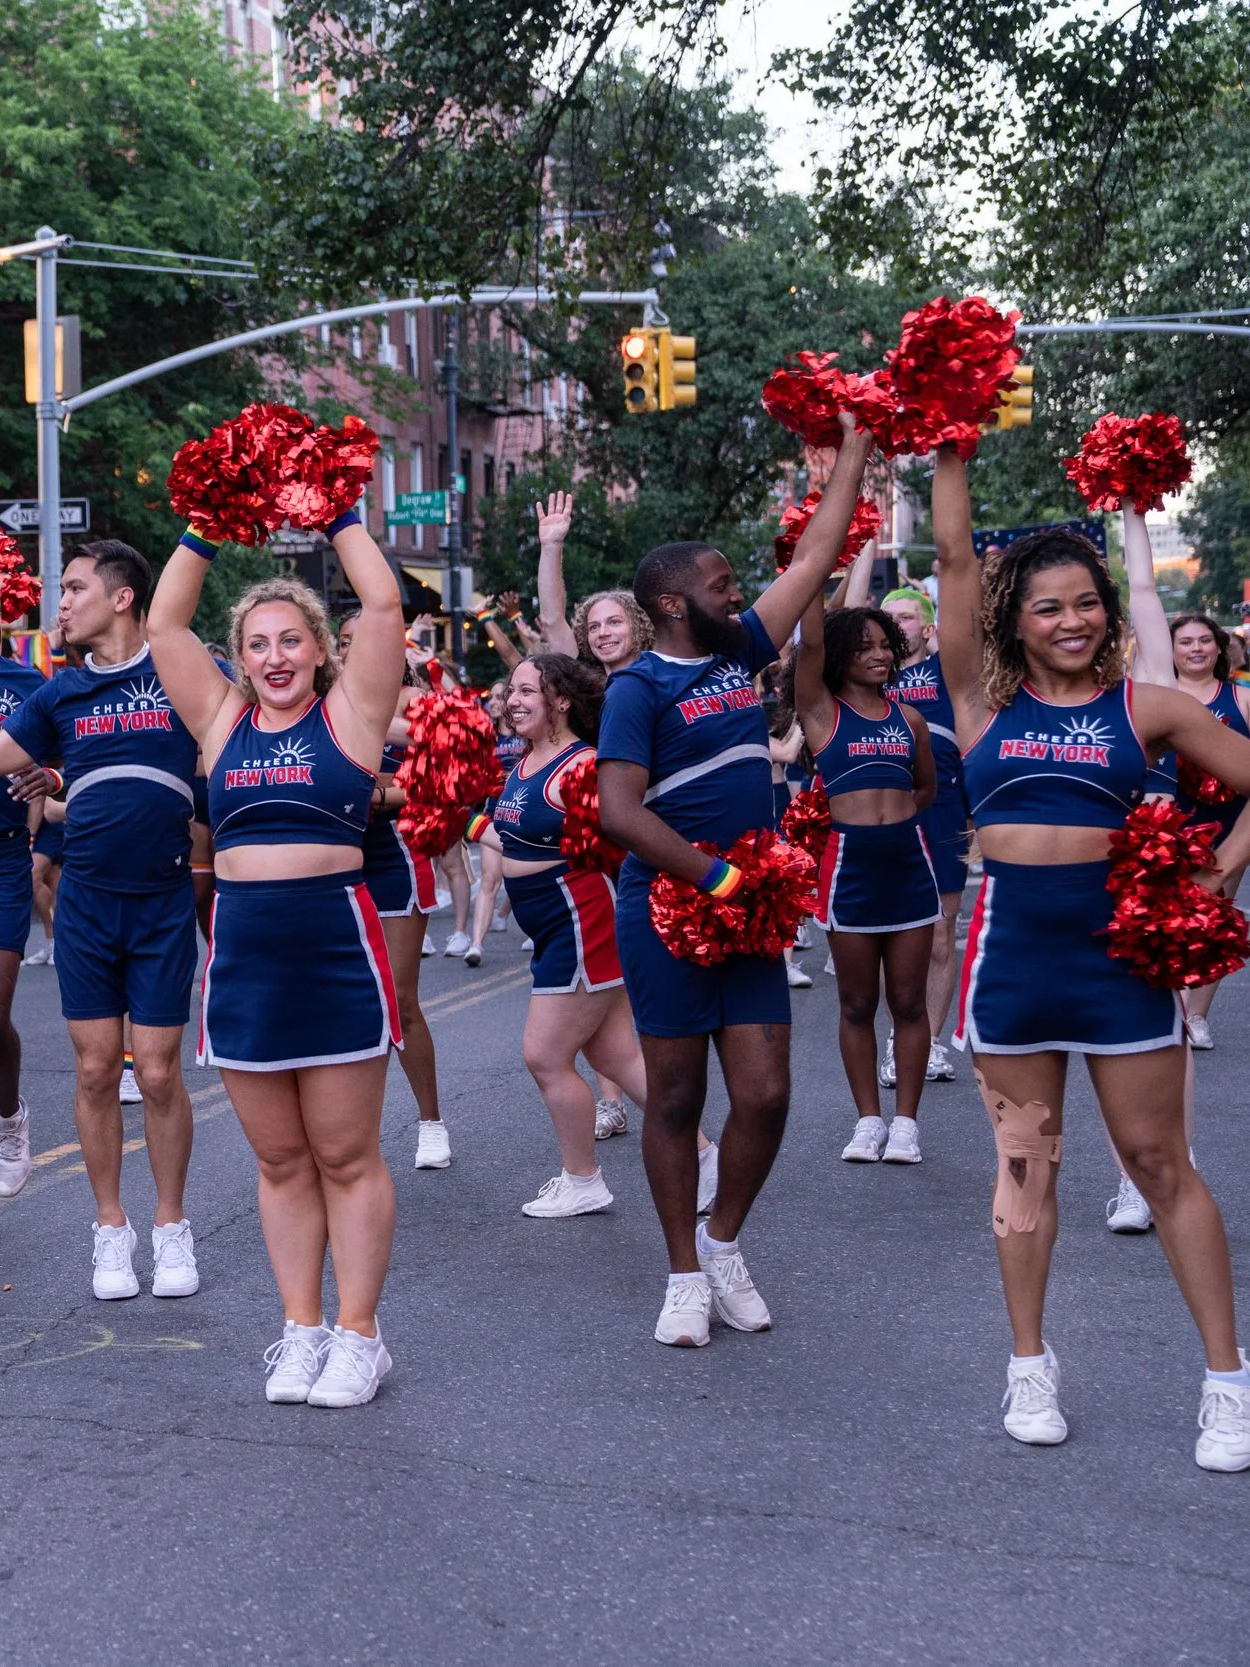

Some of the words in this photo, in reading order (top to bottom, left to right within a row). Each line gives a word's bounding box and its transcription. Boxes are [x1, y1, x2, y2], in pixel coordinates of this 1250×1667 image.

[11, 511, 39, 523] ONE
[692, 678, 742, 696] CHEER
[882, 680, 922, 689] CEER
[901, 685, 939, 702] YORK
[93, 700, 148, 715] CHEER
[675, 694, 724, 725] NEW
[718, 686, 763, 711] YORK
[75, 714, 116, 740] NEW
[117, 709, 173, 732] YORK
[1024, 731, 1087, 744] CHEER
[848, 742, 877, 757] NEW
[878, 742, 910, 758] YORK
[998, 739, 1050, 760] NEW
[1051, 744, 1110, 767] YORK
[242, 756, 292, 768] CHEER
[225, 768, 262, 790] NEW
[263, 765, 314, 786] YORK
